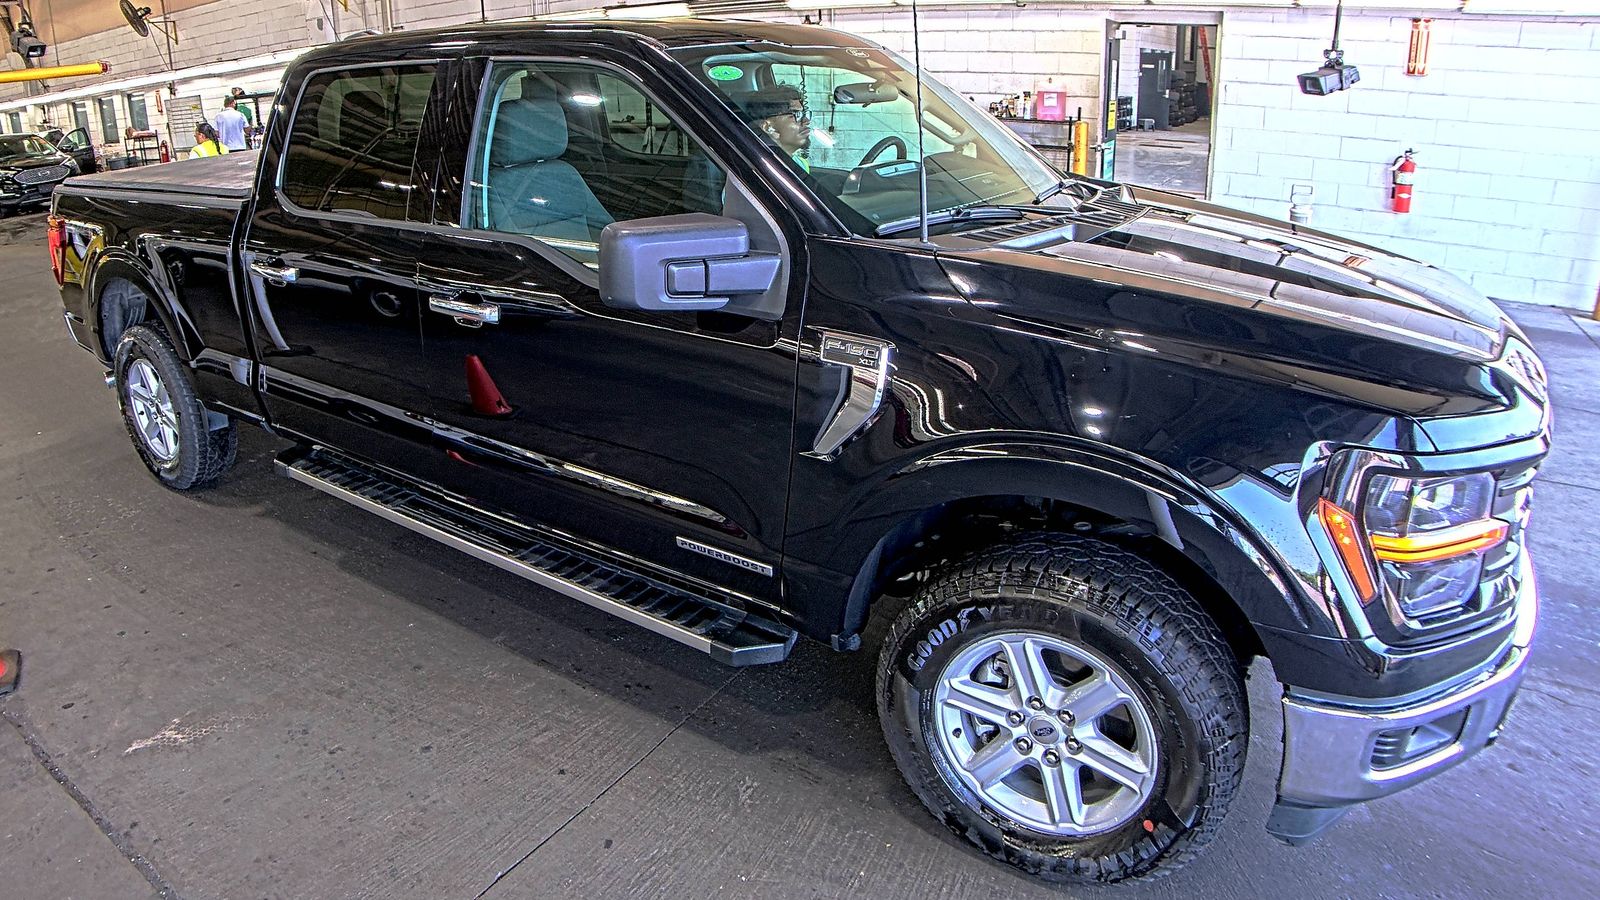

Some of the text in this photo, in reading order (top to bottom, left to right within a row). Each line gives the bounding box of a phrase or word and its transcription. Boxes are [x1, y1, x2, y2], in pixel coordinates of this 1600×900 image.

[824, 339, 879, 359] F-150
[859, 358, 875, 367] XLT
[680, 539, 767, 573] POWERBOOST
